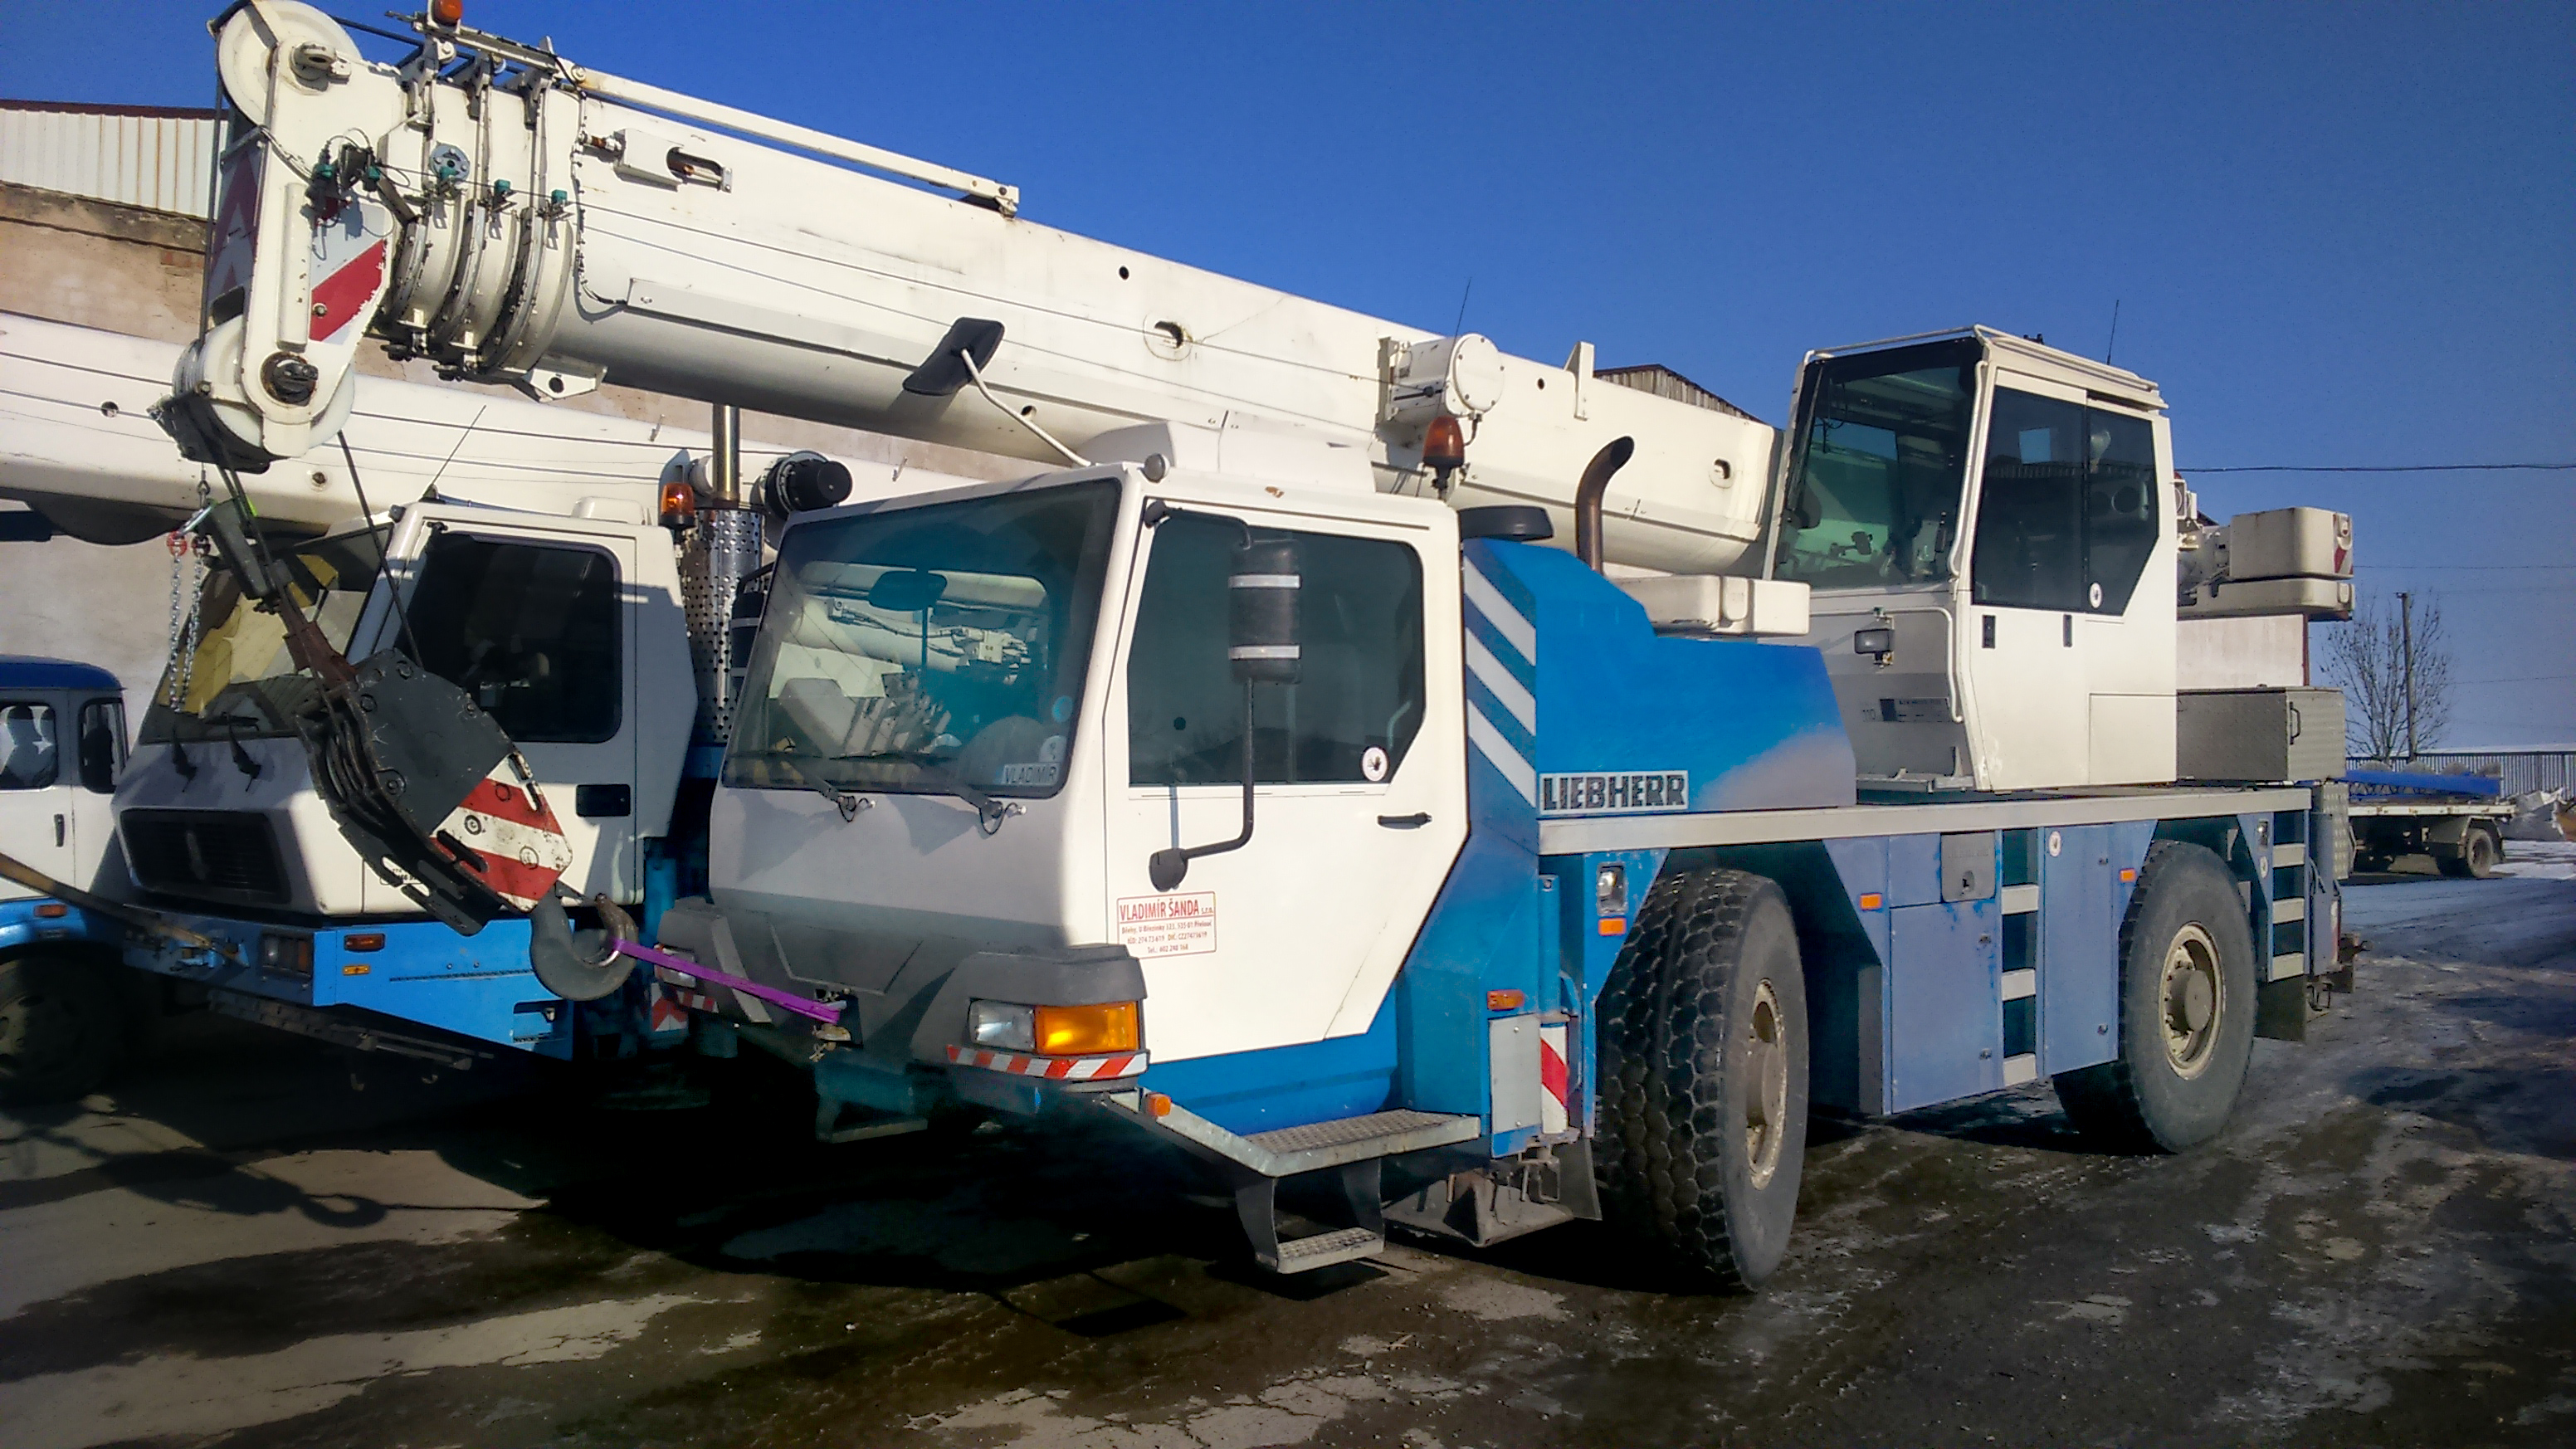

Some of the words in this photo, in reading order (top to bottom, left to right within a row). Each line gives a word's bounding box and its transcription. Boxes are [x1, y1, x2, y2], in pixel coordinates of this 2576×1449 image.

[1544, 774, 1686, 810] LIEBHERR
[1120, 899, 1167, 921] VLADIMÍR
[1168, 898, 1199, 917] ŠANDA
